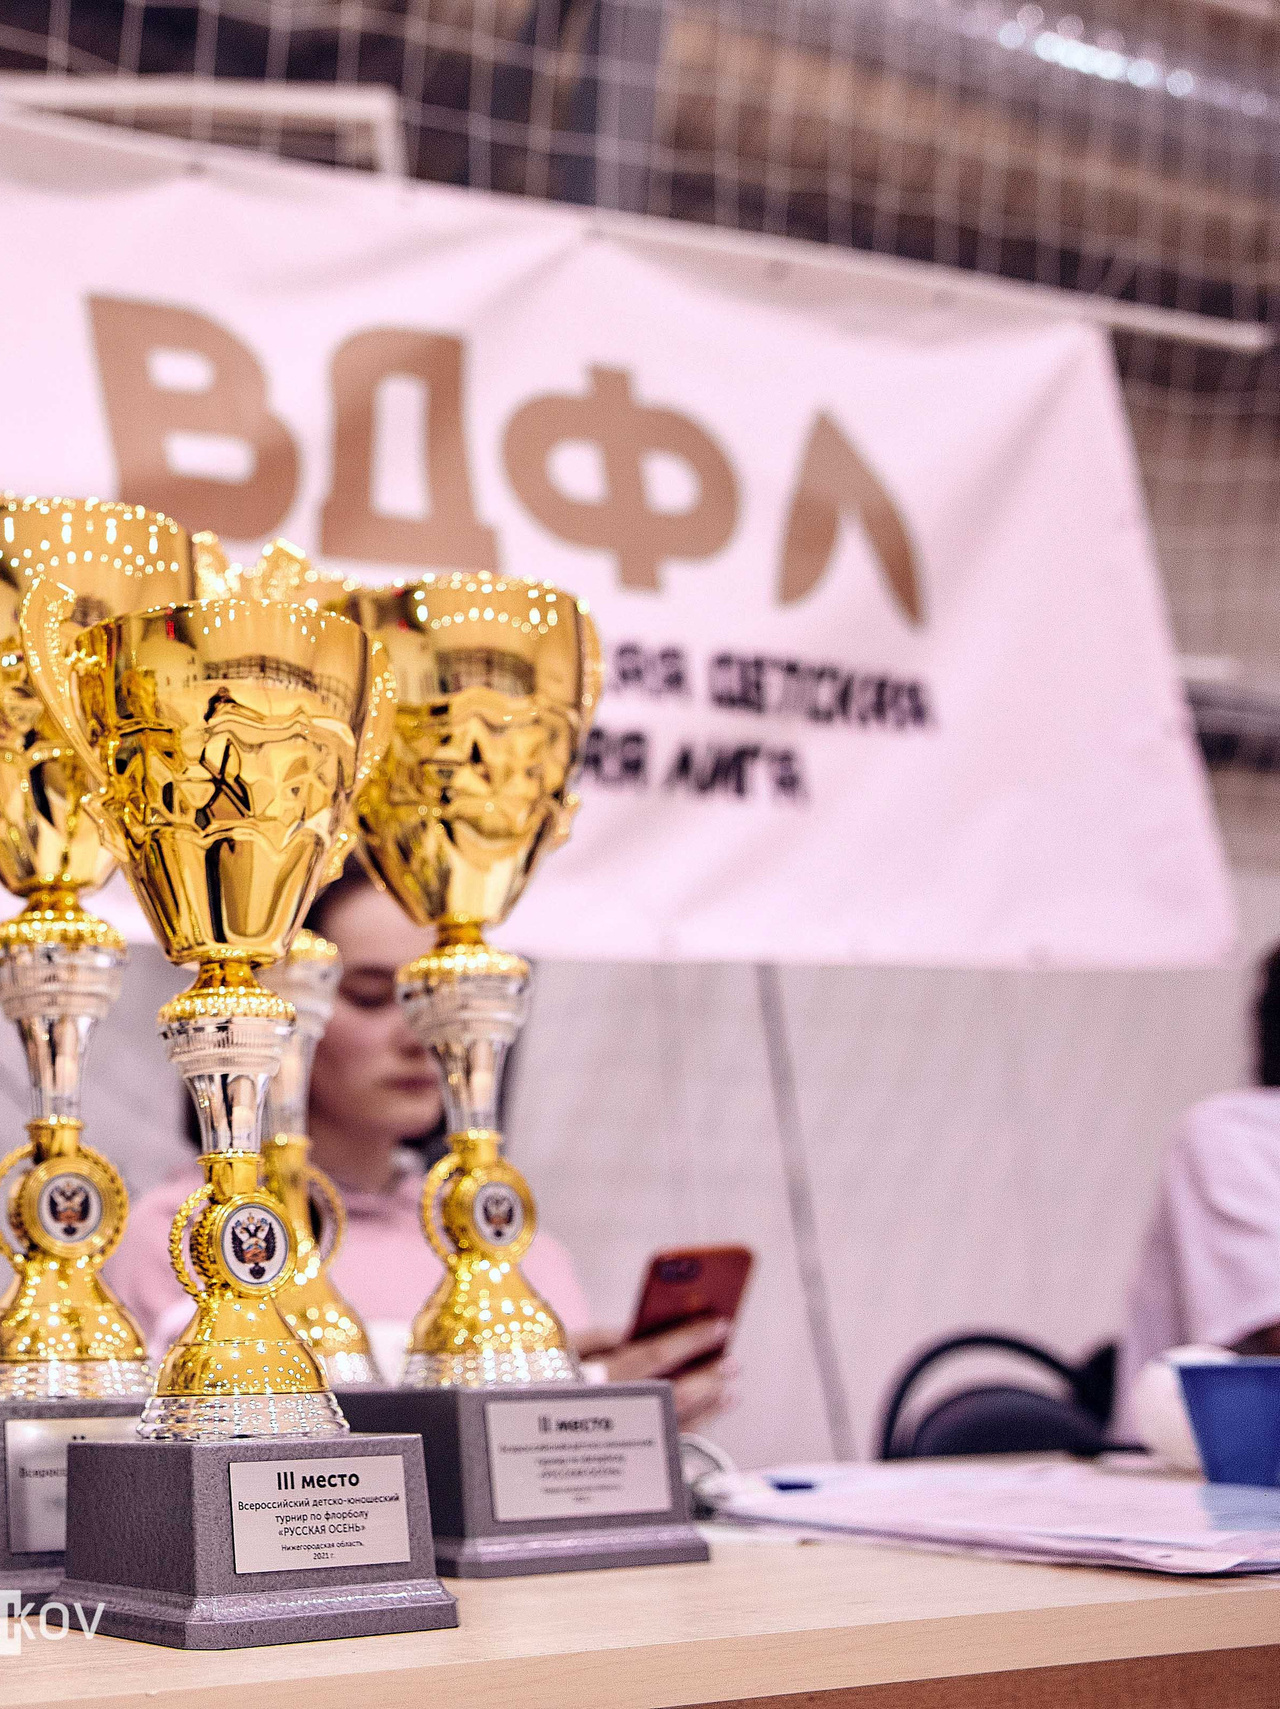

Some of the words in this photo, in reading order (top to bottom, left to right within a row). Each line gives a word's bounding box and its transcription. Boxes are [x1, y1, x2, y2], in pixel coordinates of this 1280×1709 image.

[86, 293, 929, 629] ВДФЛ
[277, 1471, 295, 1490] III
[301, 1473, 359, 1489] место
[238, 1498, 310, 1511] Всероссийский
[275, 1514, 308, 1524] турнир
[324, 1509, 369, 1521] флорболу
[278, 1525, 326, 1537] «РУССКАЯ
[328, 1523, 366, 1534] ОСЕНЬ»
